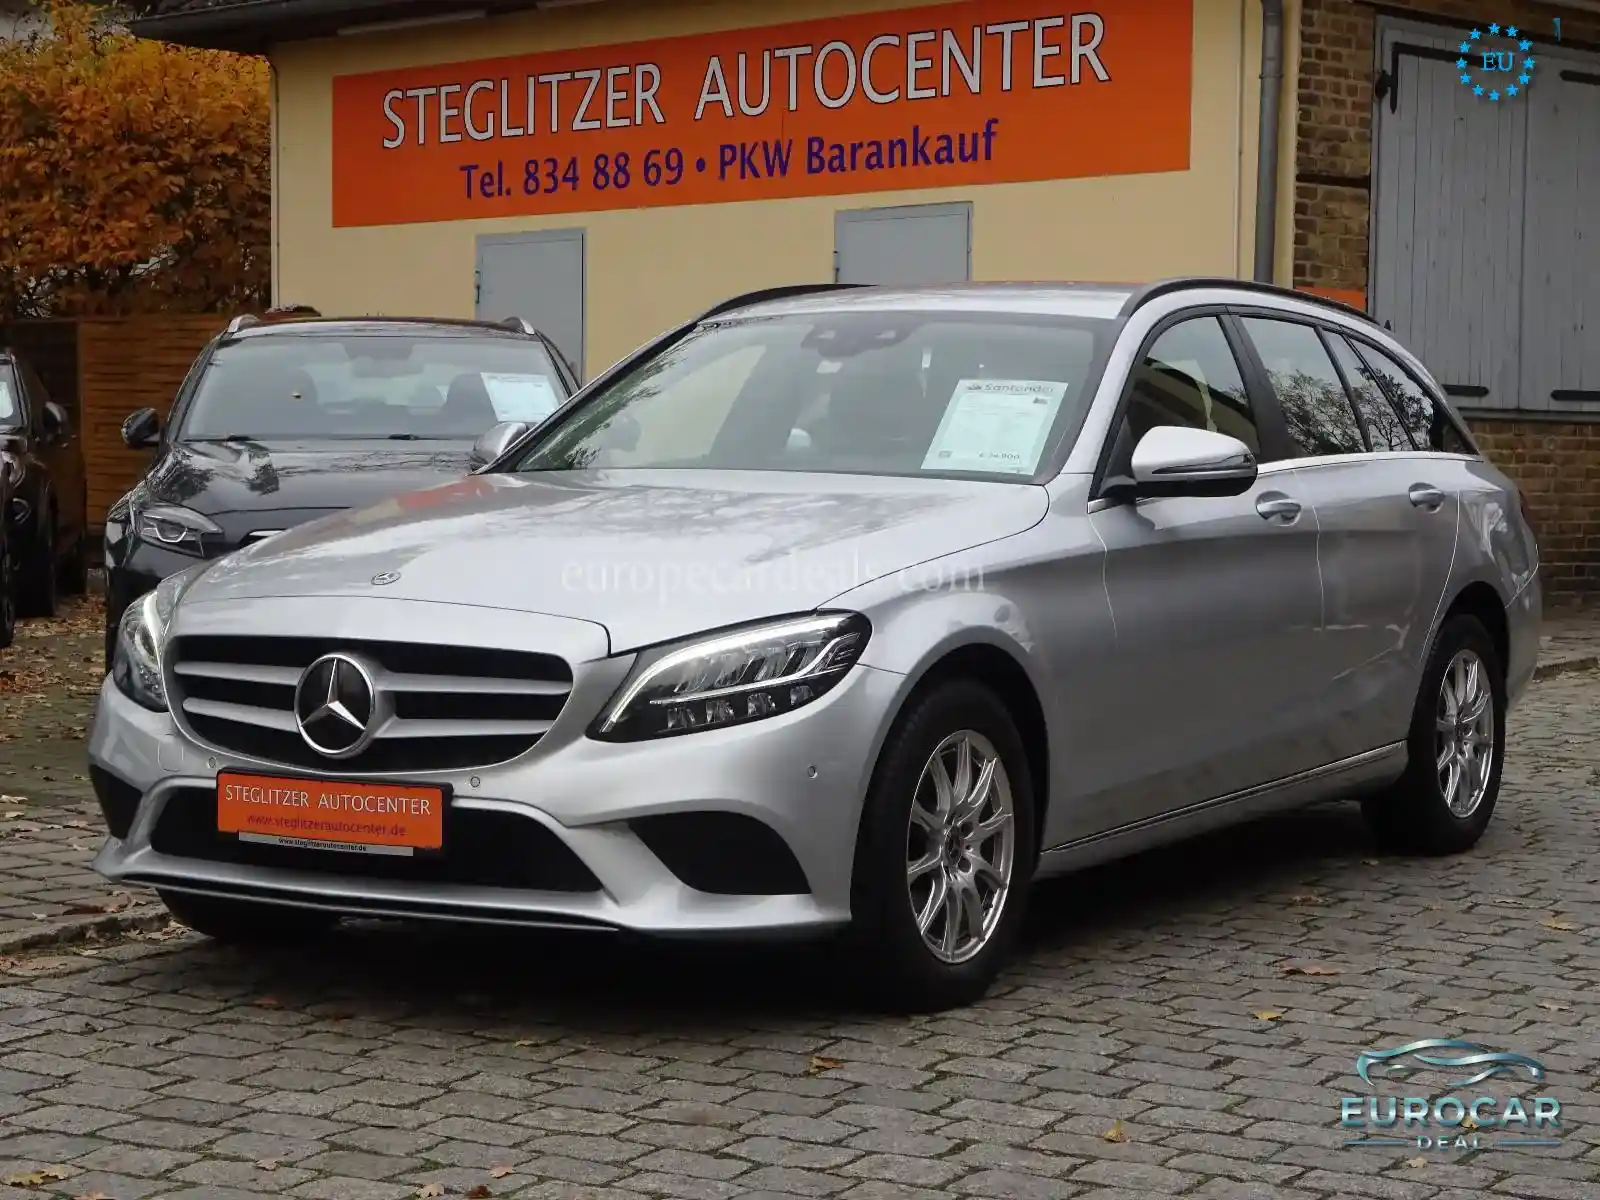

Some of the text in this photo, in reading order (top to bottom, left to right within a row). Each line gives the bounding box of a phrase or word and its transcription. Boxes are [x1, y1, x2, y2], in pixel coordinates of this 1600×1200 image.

[382, 12, 1111, 150] STEGLITZER AUTOCENTER
[459, 117, 999, 200] Tel. 834 88 69 PKW Barankauf
[225, 784, 431, 816] STEGLITZER AUTOCENTER
[246, 813, 407, 837] www.steglitzerautocenter.de
